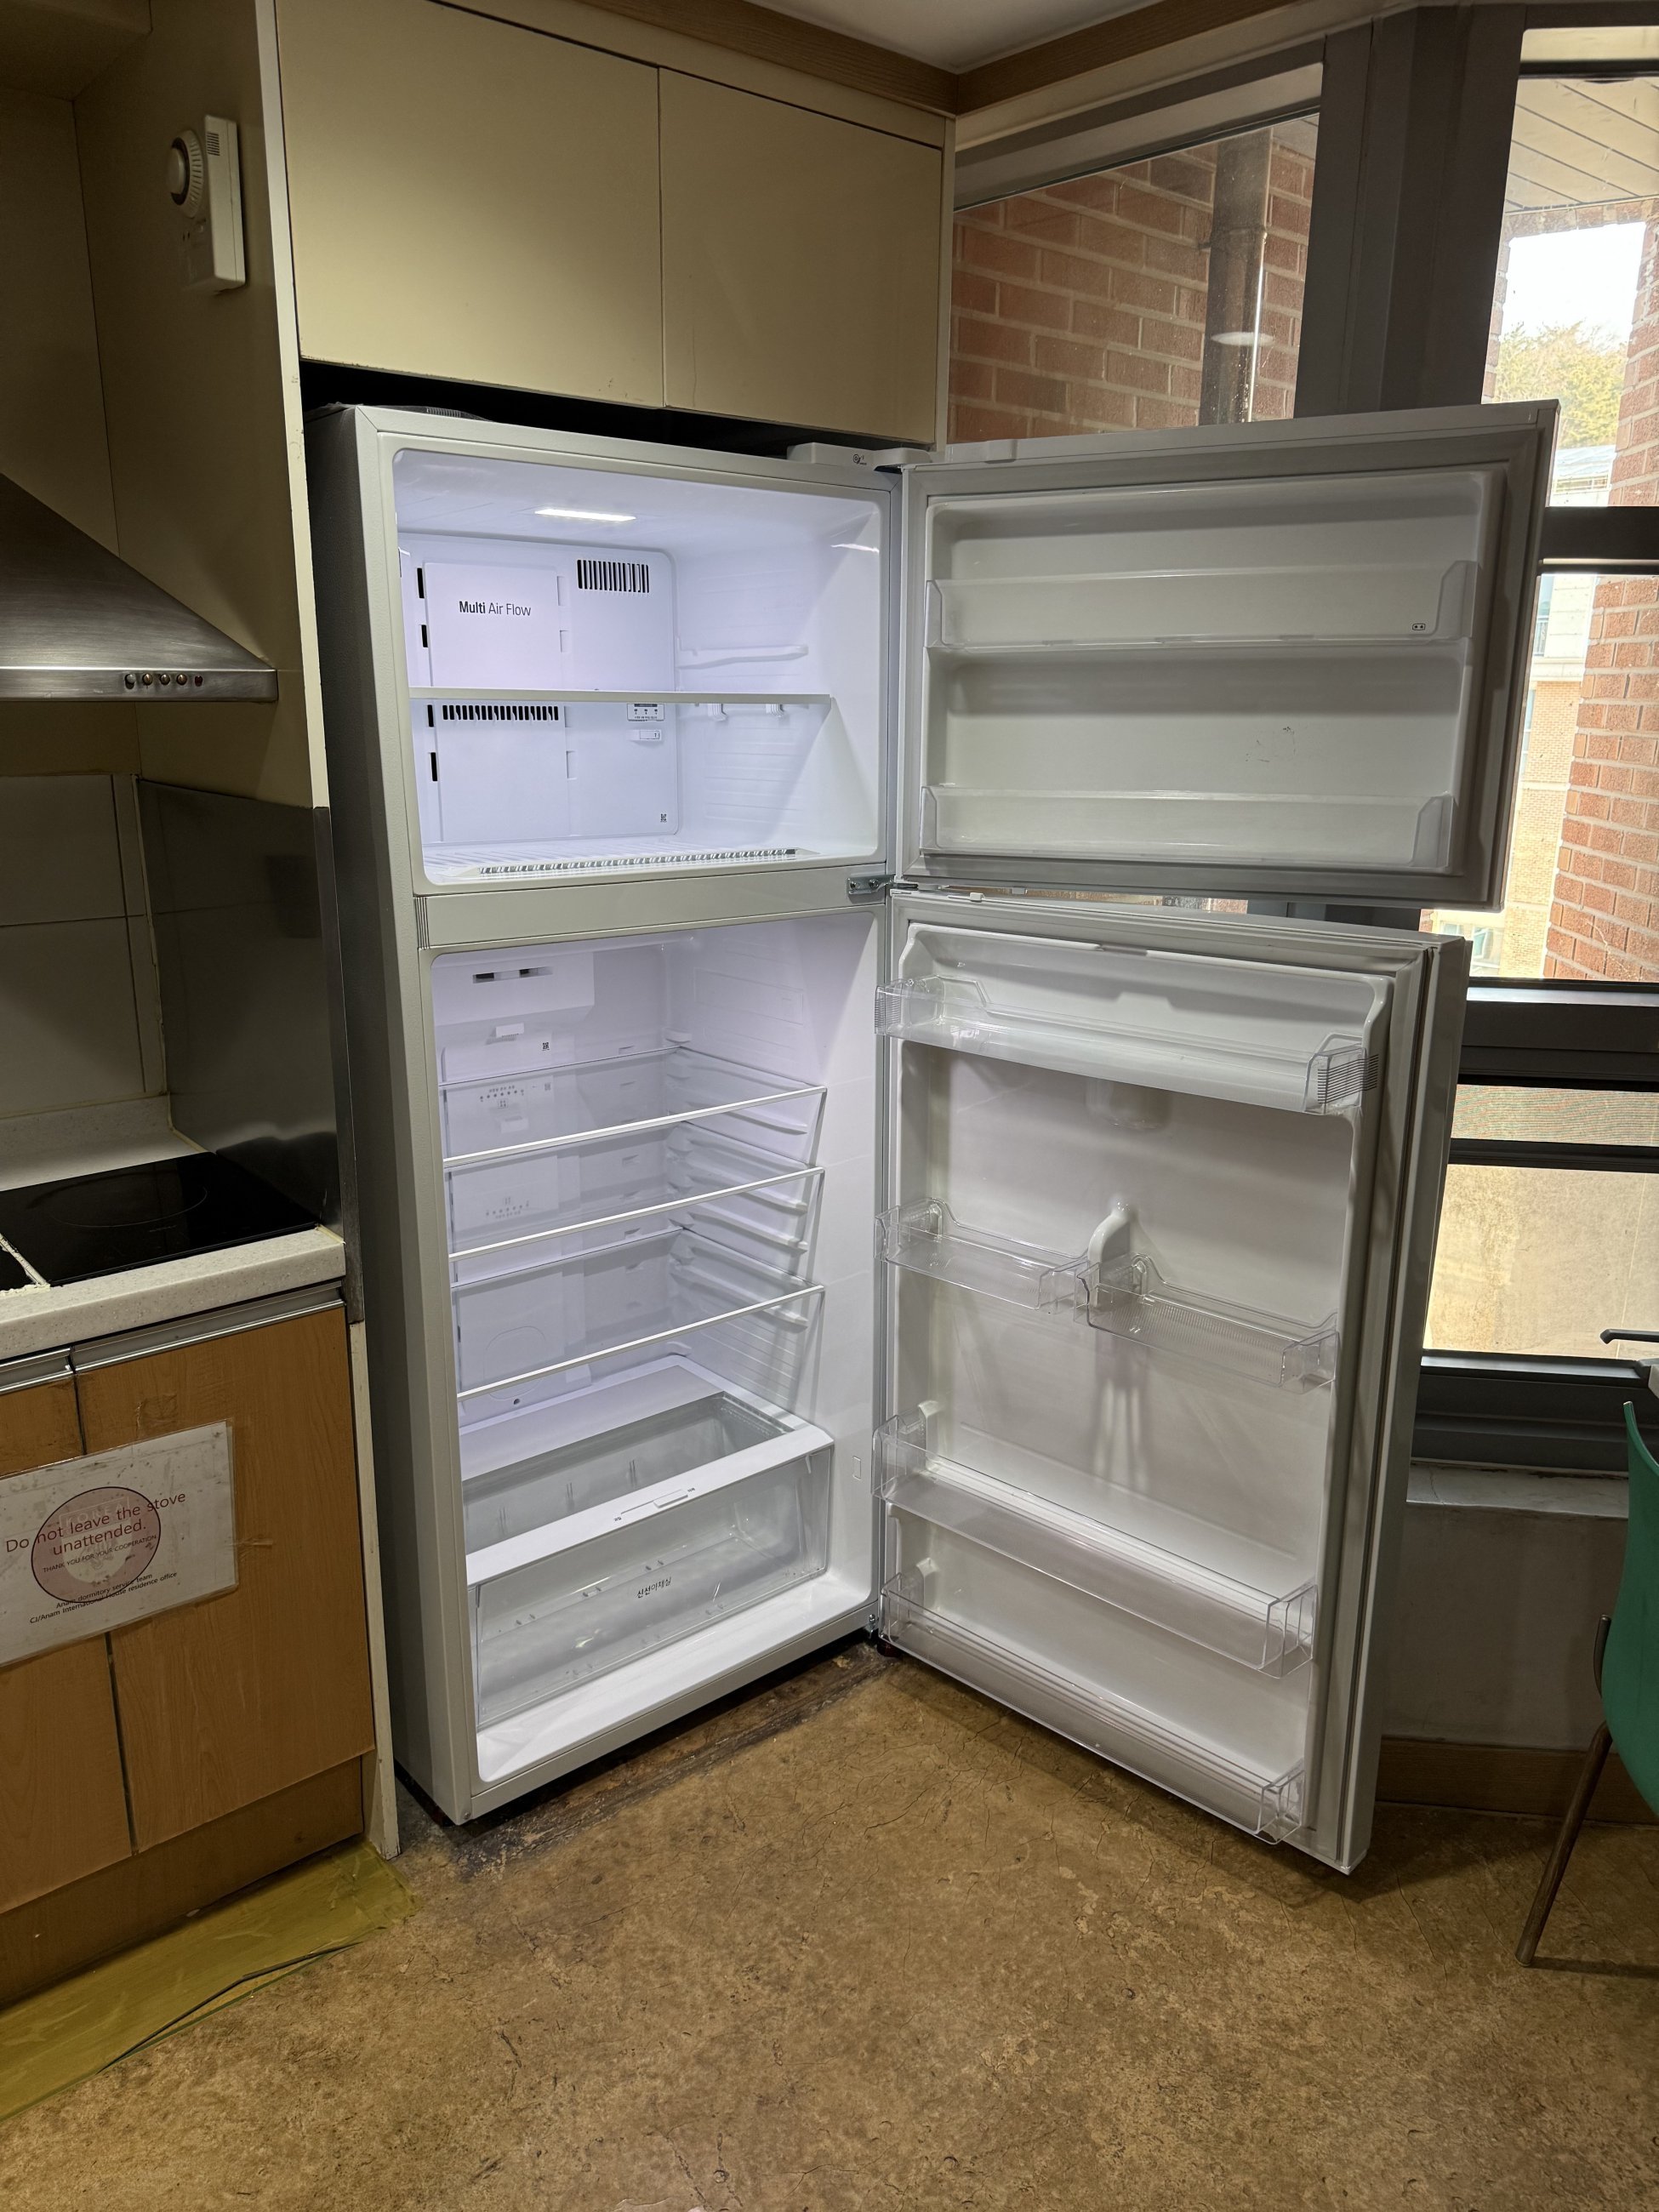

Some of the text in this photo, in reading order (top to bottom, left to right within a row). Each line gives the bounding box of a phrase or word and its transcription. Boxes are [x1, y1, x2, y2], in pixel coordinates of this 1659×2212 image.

[459, 601, 532, 616] Multi Air Flow
[7, 1493, 185, 1553] Do not leave the stove
[53, 1519, 146, 1555] unattended.
[43, 1535, 157, 1572] THANK YOU FOR YOUR COOPERATION
[77, 1588, 111, 1601] dormitory
[136, 1574, 152, 1583] team
[128, 1578, 158, 1592] residence
[160, 1572, 177, 1582] office
